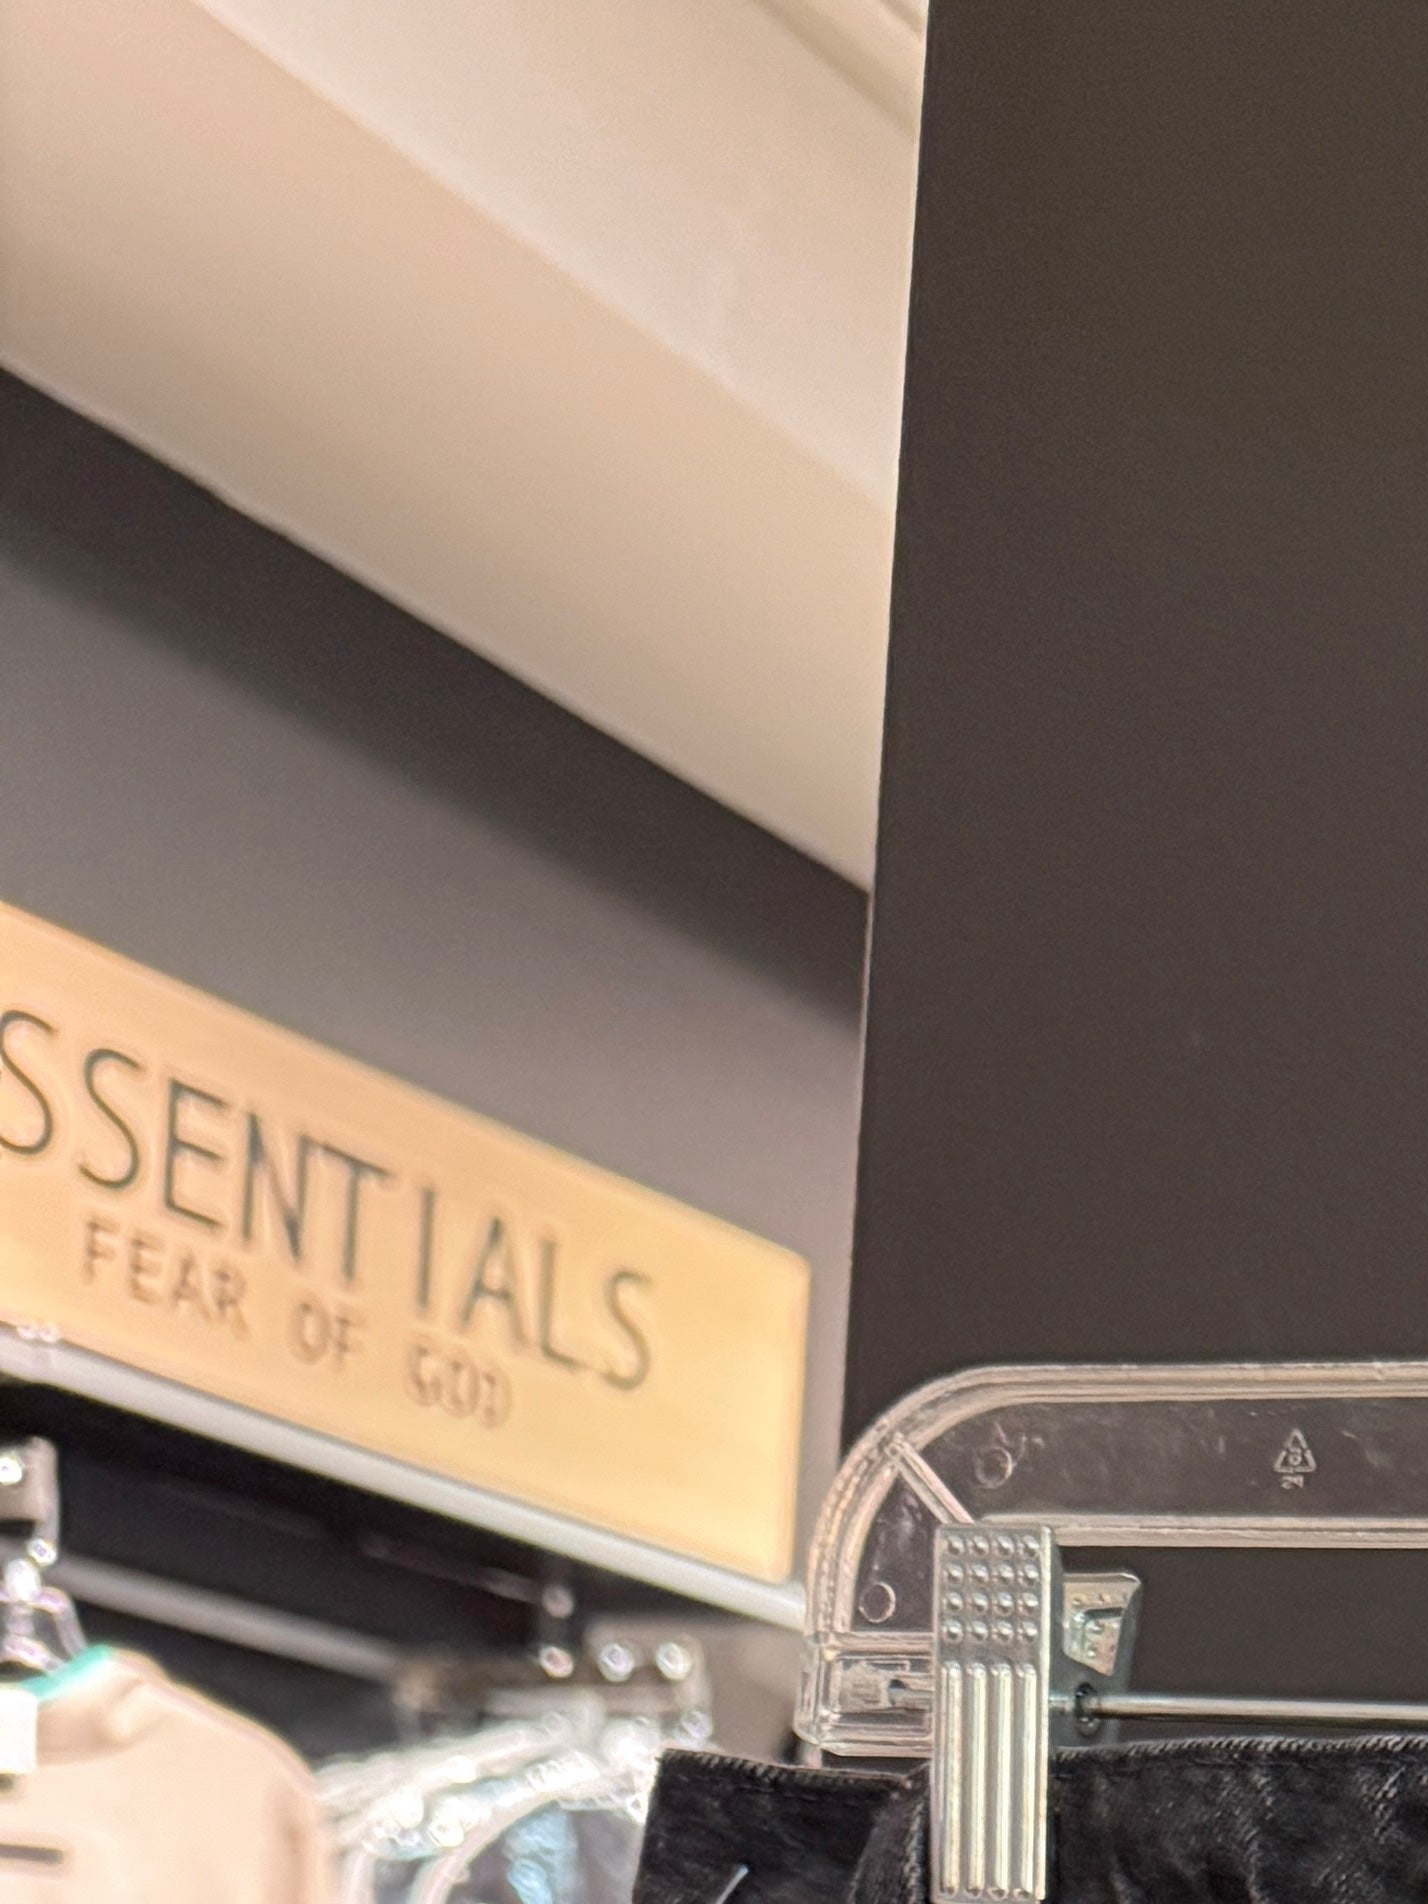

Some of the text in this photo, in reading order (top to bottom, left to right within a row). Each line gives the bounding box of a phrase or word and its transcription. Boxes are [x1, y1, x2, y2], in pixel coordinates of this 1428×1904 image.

[82, 1220, 513, 1429] FEAR OF GOD
